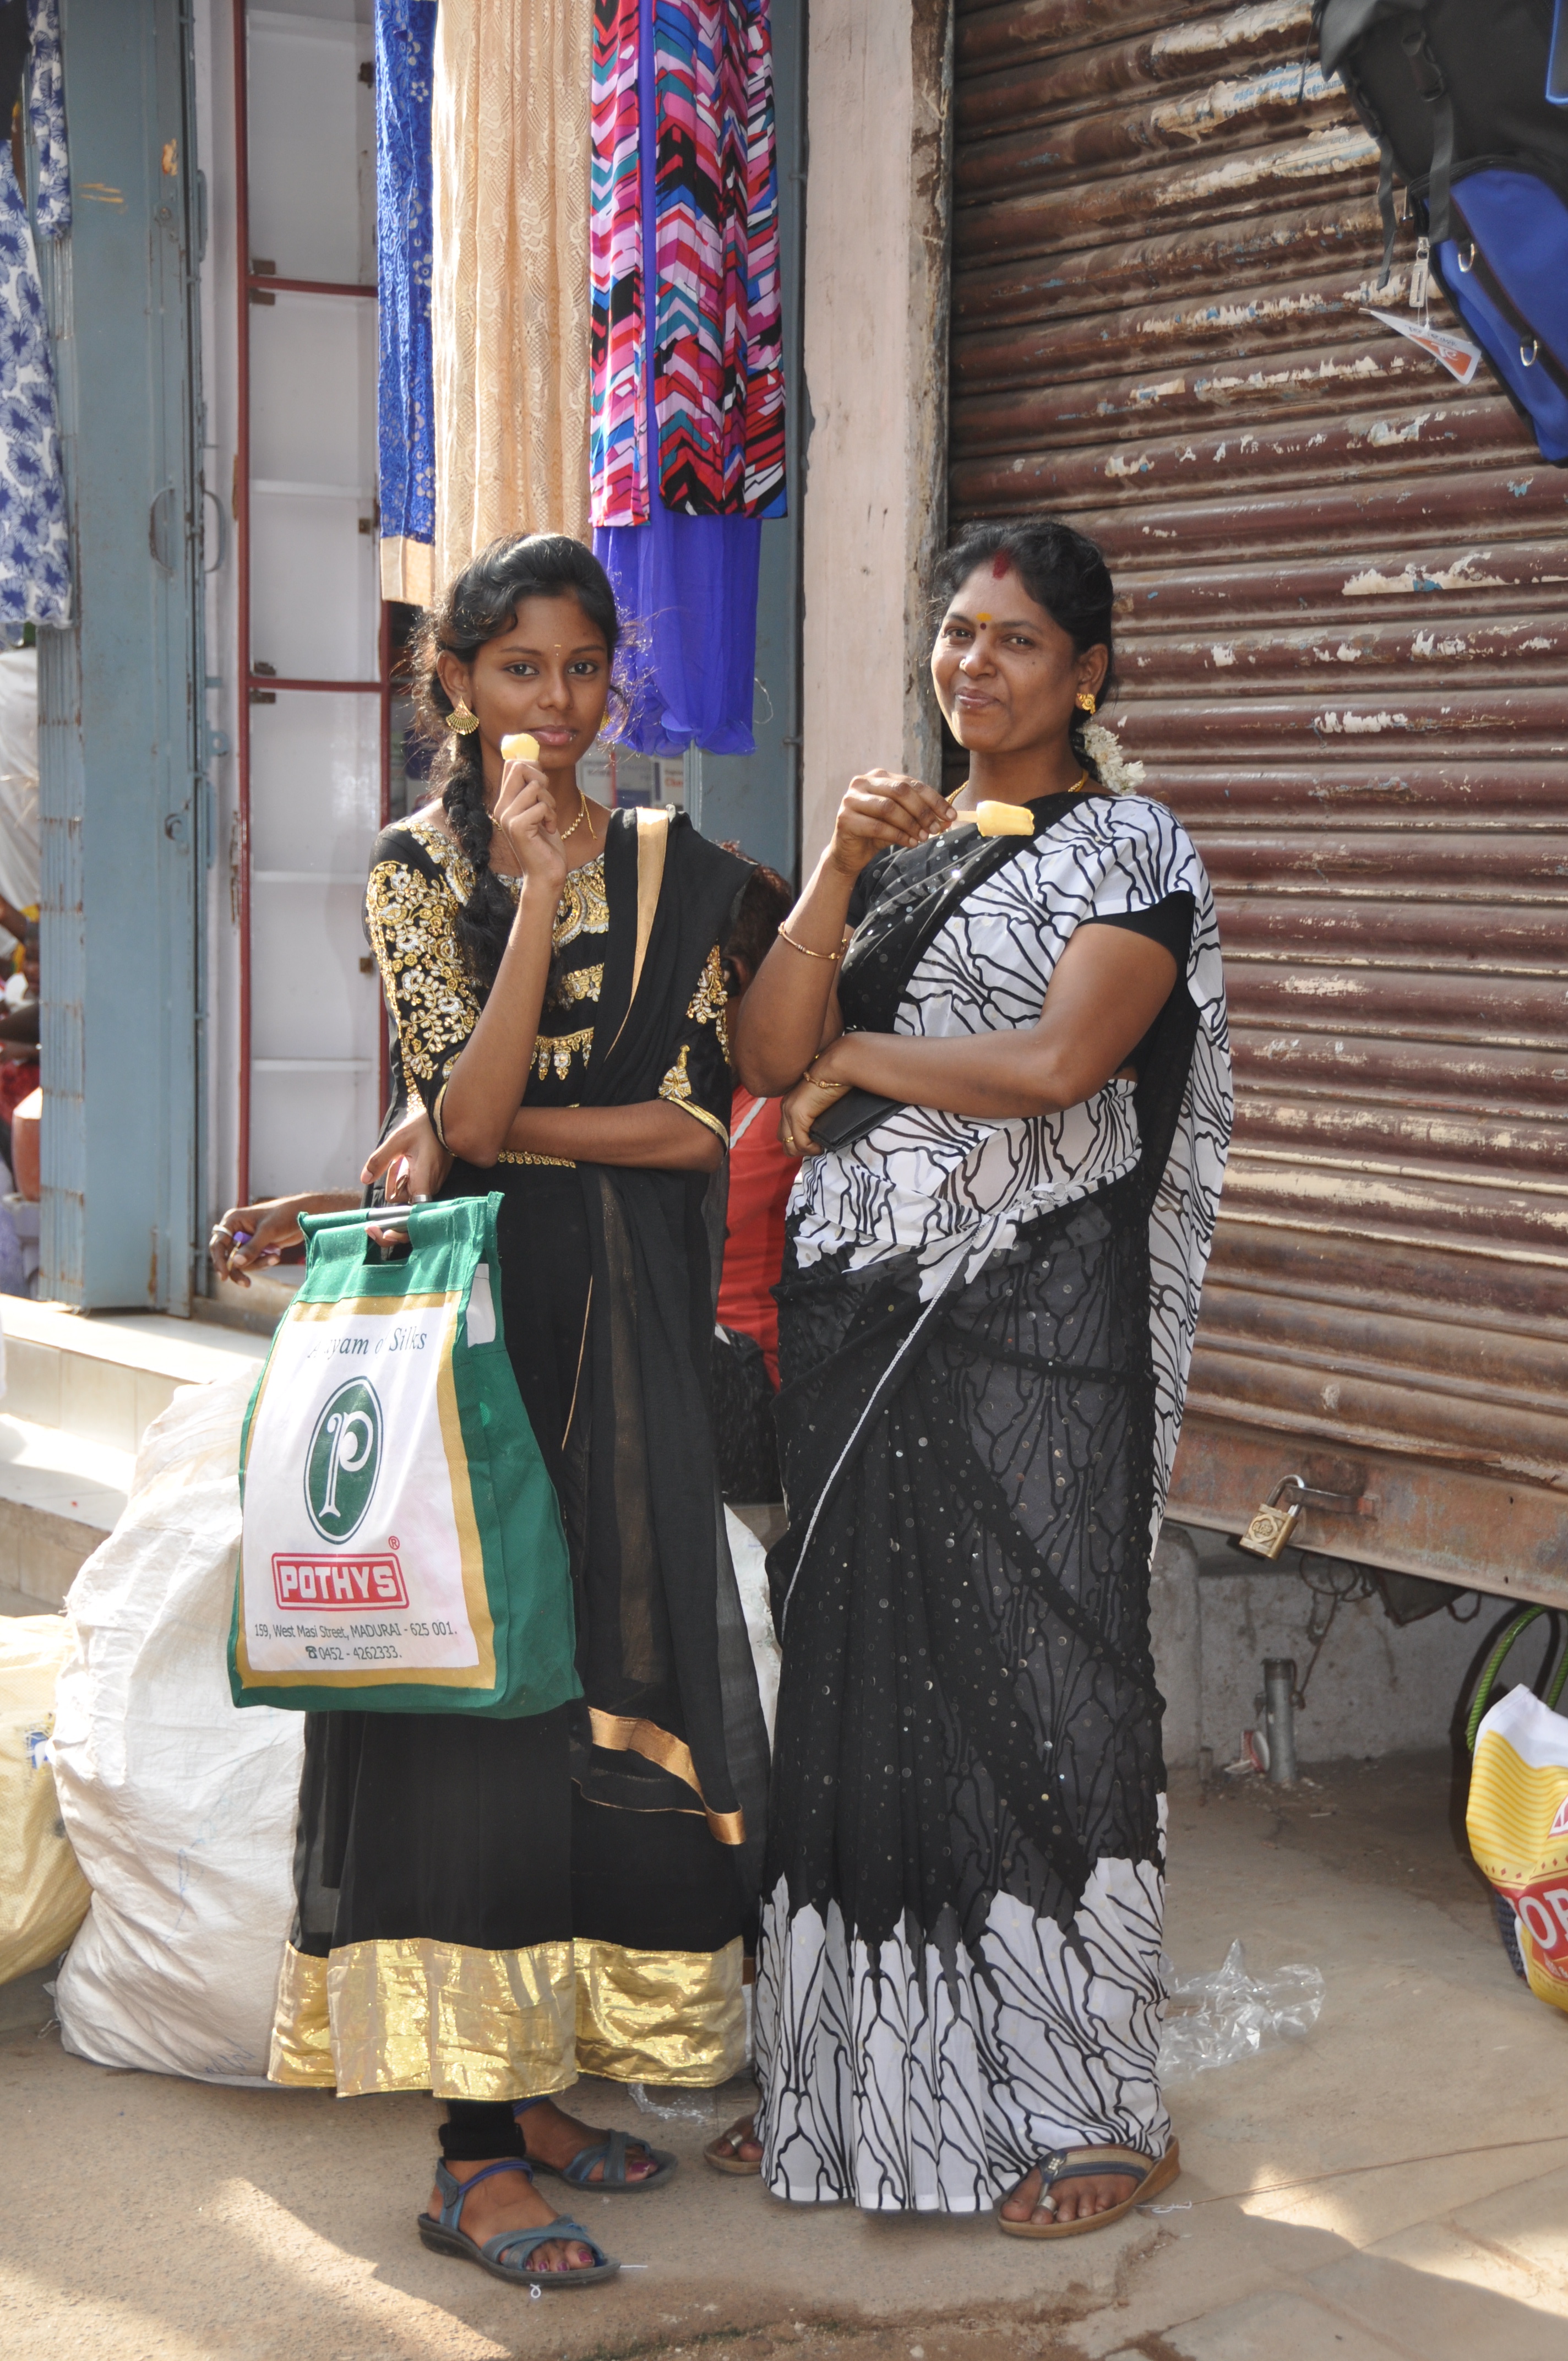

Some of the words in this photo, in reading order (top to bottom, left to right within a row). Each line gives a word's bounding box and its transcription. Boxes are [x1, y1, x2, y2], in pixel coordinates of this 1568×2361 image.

[388, 1325, 427, 1351] Silks
[279, 1565, 398, 1599] POTHYS
[255, 1623, 271, 1640] 159,
[273, 1624, 296, 1638] West
[296, 1625, 318, 1638] Masi
[319, 1625, 350, 1641] Street,
[350, 1623, 402, 1638] MADURAI
[410, 1622, 429, 1636] 625
[432, 1620, 458, 1636] 001.
[318, 1646, 345, 1661] 0452
[353, 1645, 402, 1660] 4262333.
